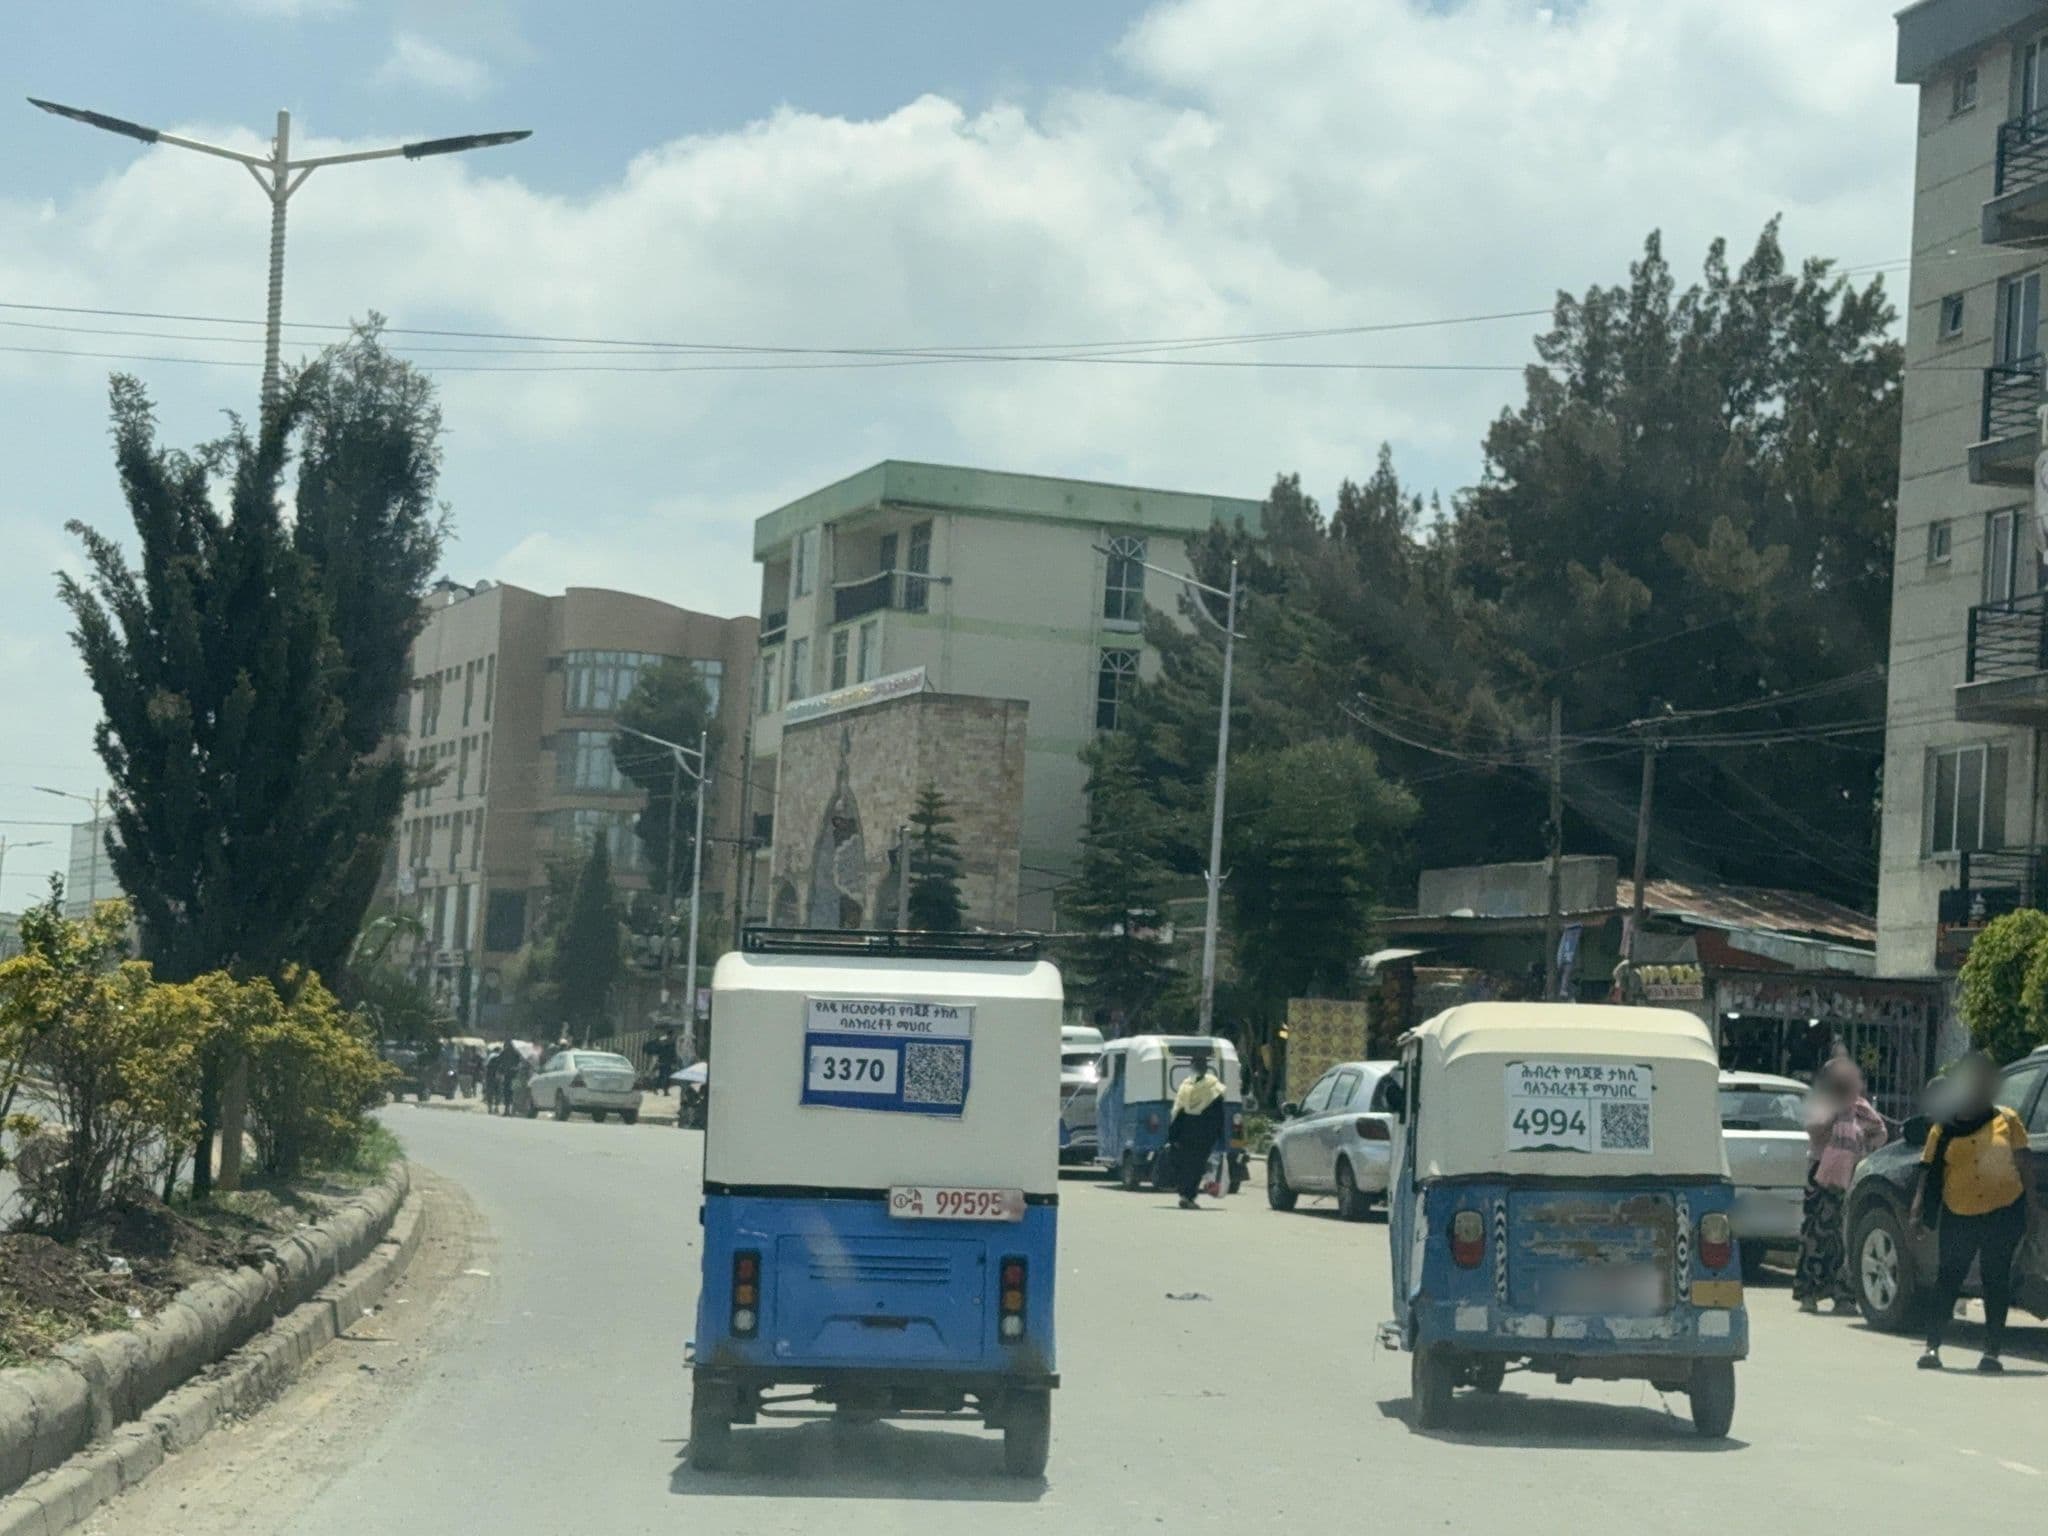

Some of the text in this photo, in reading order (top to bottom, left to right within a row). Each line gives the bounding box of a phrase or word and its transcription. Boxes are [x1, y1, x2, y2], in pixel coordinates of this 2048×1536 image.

[822, 1056, 885, 1082] 3370
[1564, 1066, 1603, 1081] የባጃጅ
[1608, 1067, 1639, 1082] ታክሲ
[1523, 1081, 1637, 1098] ባለንብረቶች ማህበር
[1512, 1108, 1587, 1136] 4994
[936, 1190, 1003, 1217] 99595
